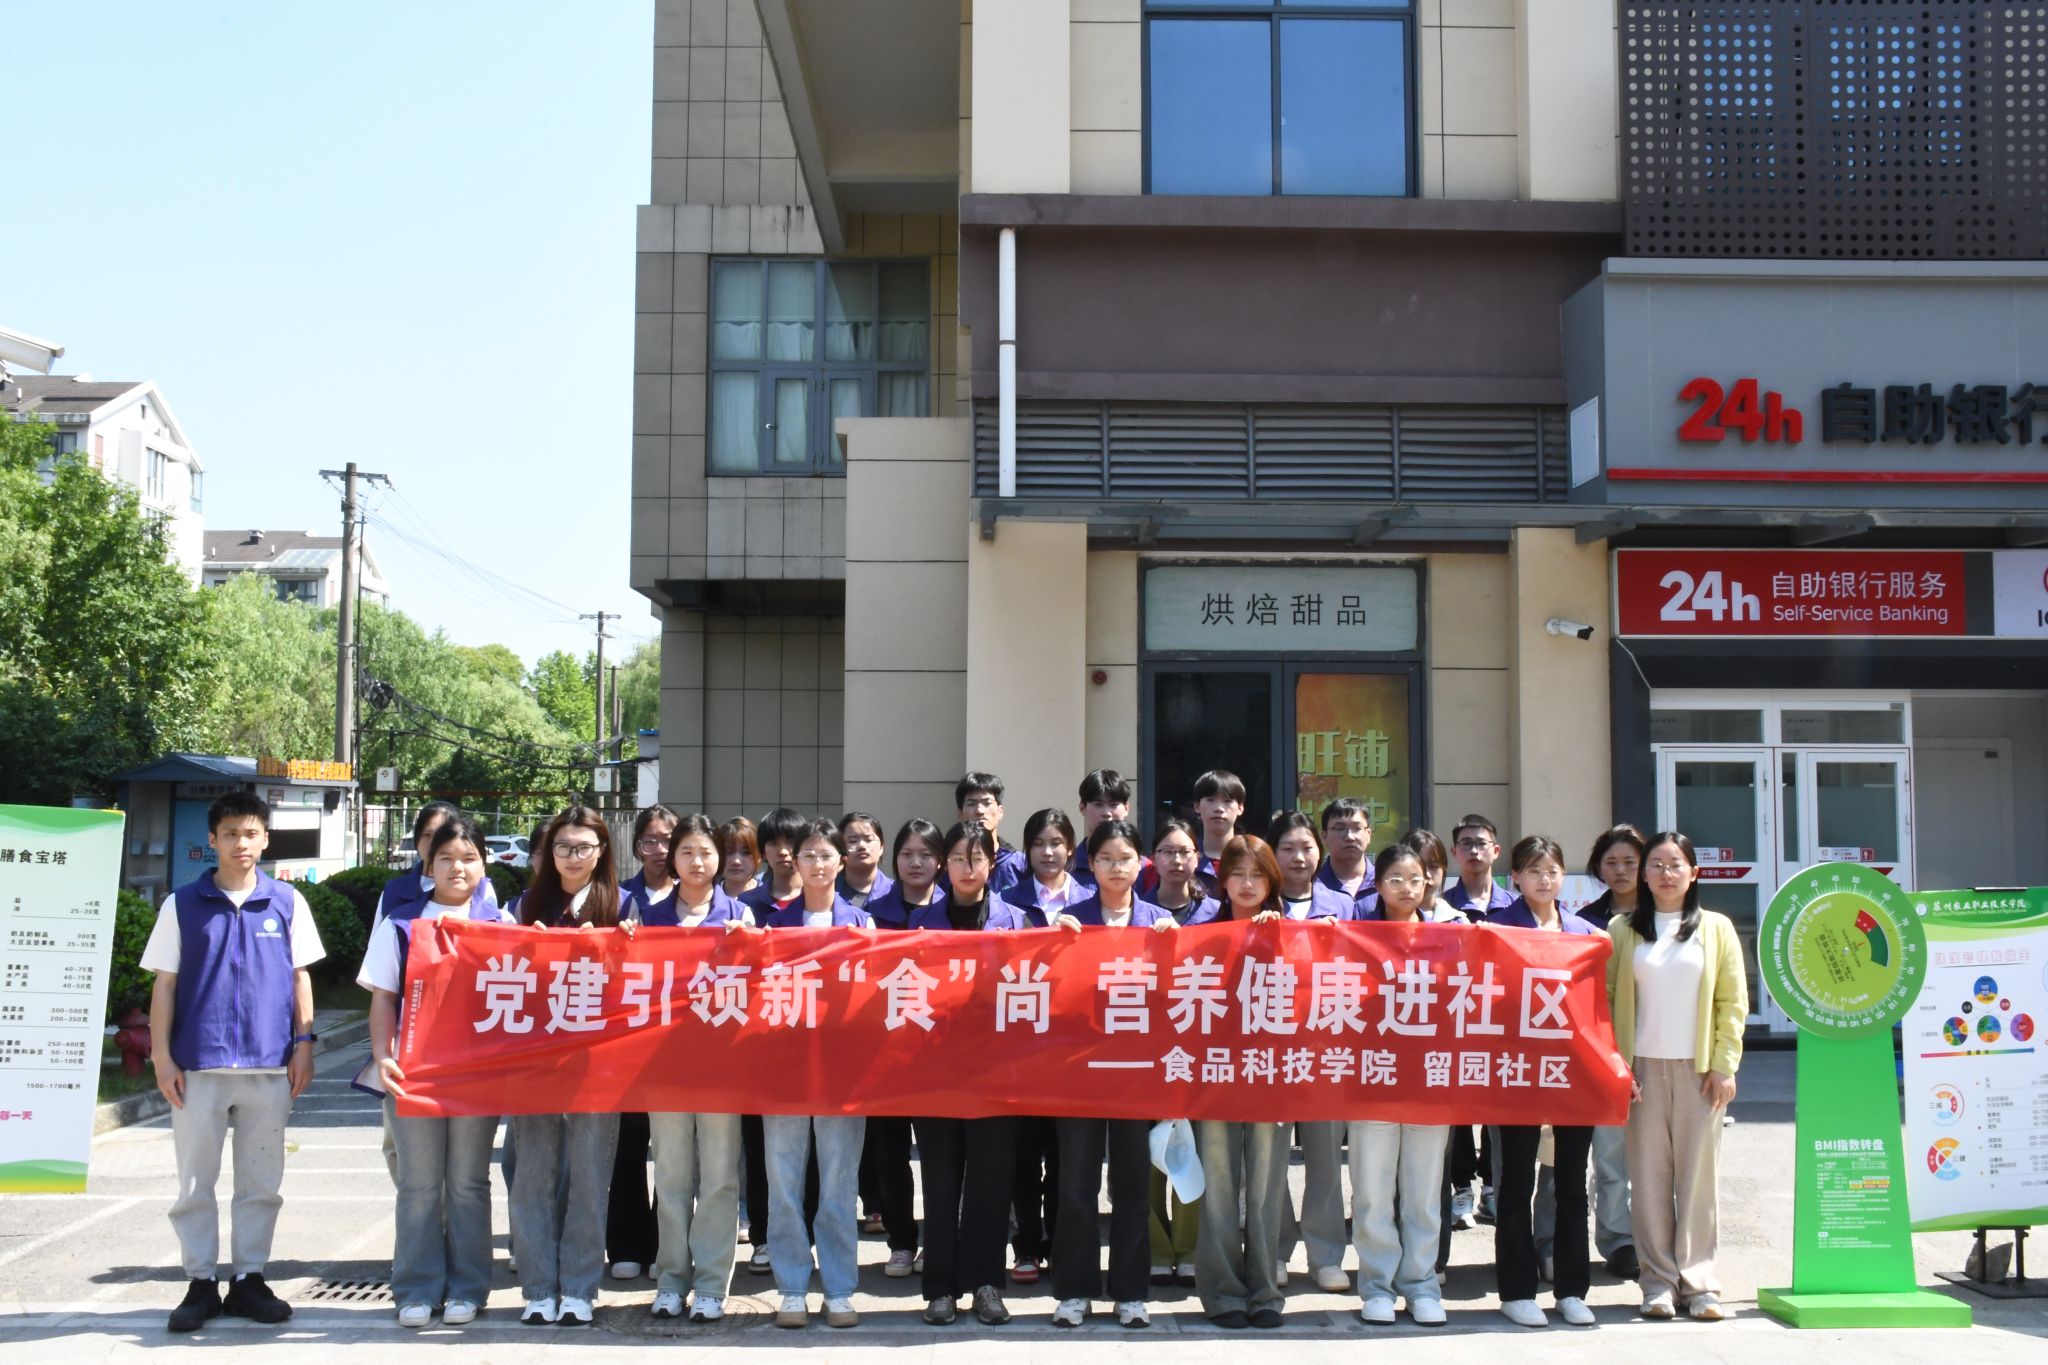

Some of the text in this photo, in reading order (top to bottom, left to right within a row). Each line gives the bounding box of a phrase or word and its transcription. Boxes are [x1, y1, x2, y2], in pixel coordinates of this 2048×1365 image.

[1676, 377, 1803, 444] 24h
[1201, 592, 1366, 627] 烘焙甜品
[1659, 570, 1948, 623] 24h 自助银行服务
[1773, 605, 1949, 626] Self-Service Banking
[1297, 728, 1391, 779] 旺铺
[0, 849, 68, 865] 膳食宝塔
[472, 955, 1051, 1035] 党建引领新“食”尚
[1096, 955, 1575, 1040] 营养健康进社区
[1423, 1050, 1572, 1089] 留园社区
[1814, 1138, 1884, 1152] BMI指数转盘
